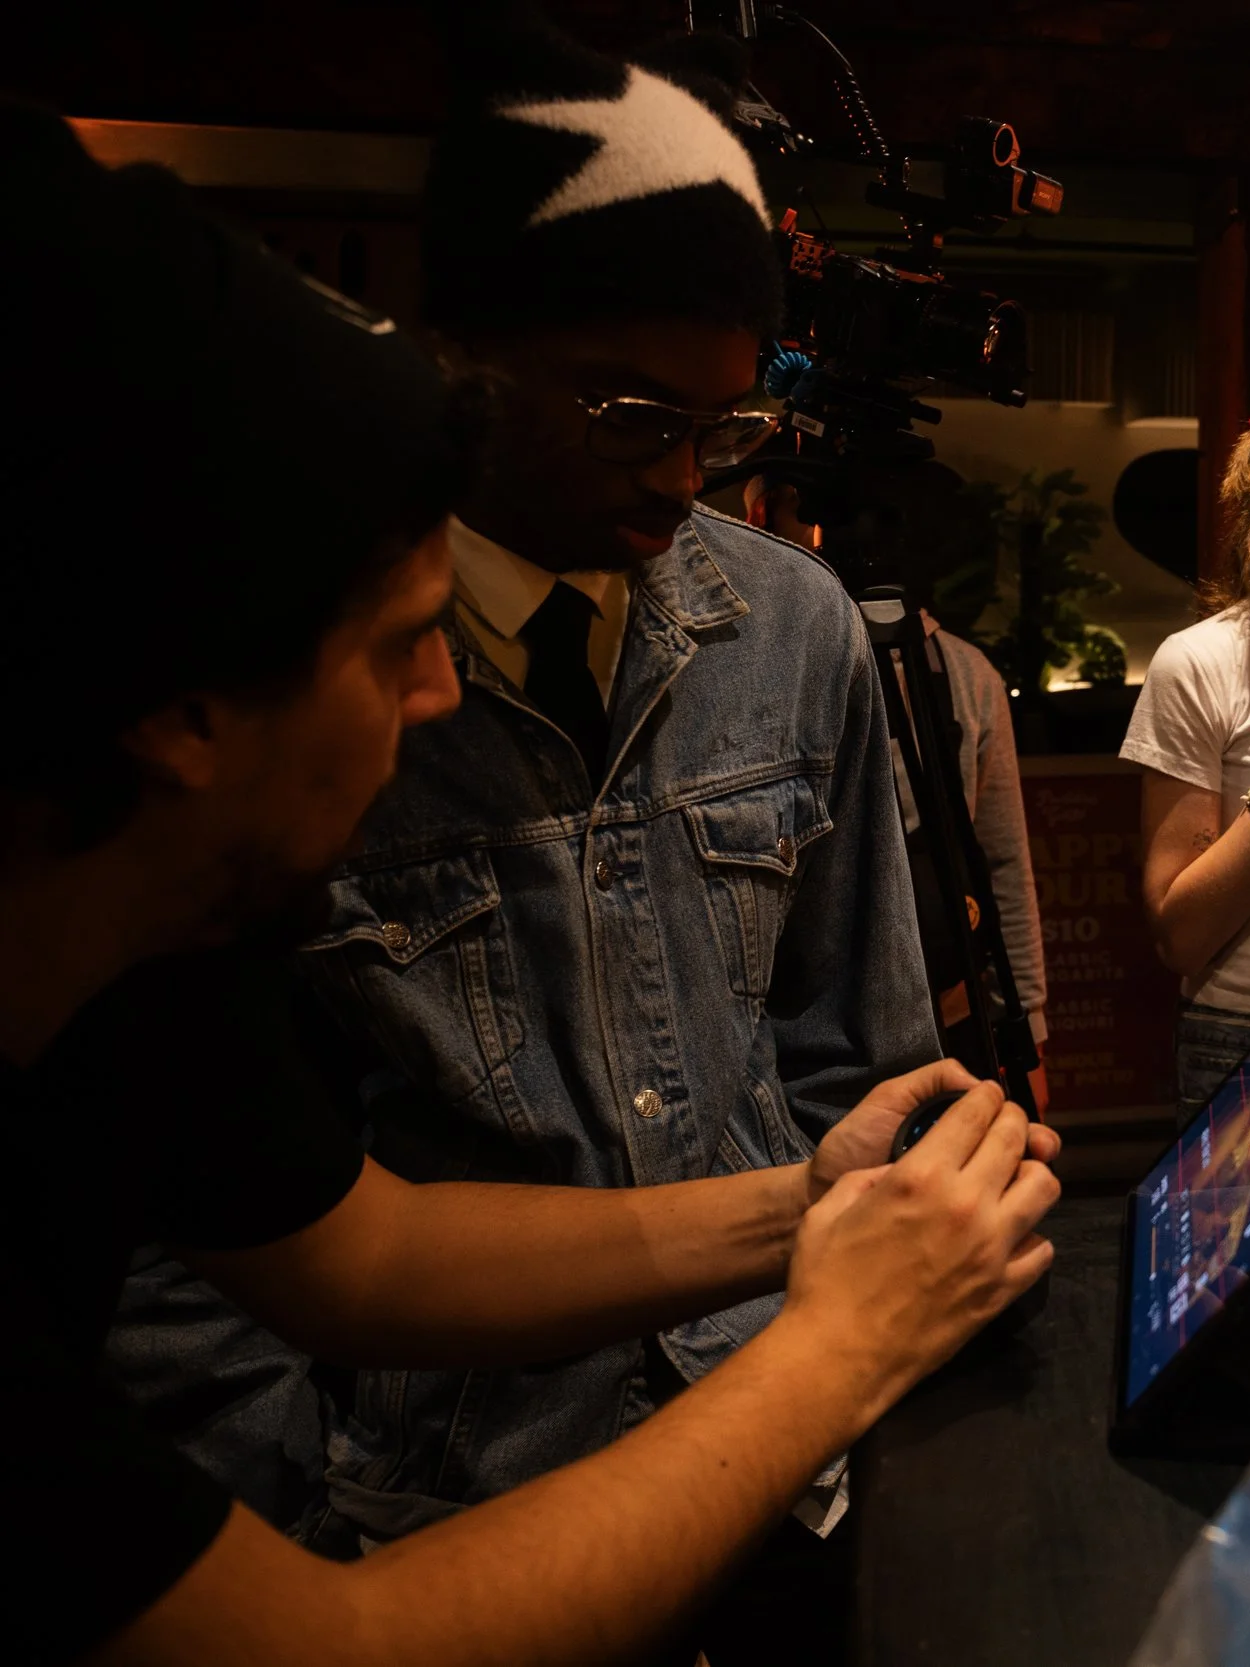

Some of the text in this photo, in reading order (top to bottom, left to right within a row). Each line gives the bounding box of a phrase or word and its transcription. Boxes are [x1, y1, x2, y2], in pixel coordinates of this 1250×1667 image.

[1030, 832, 1142, 868] APP
[1034, 872, 1133, 908] OUR
[1047, 1015, 1115, 1032] AIQUIRI
